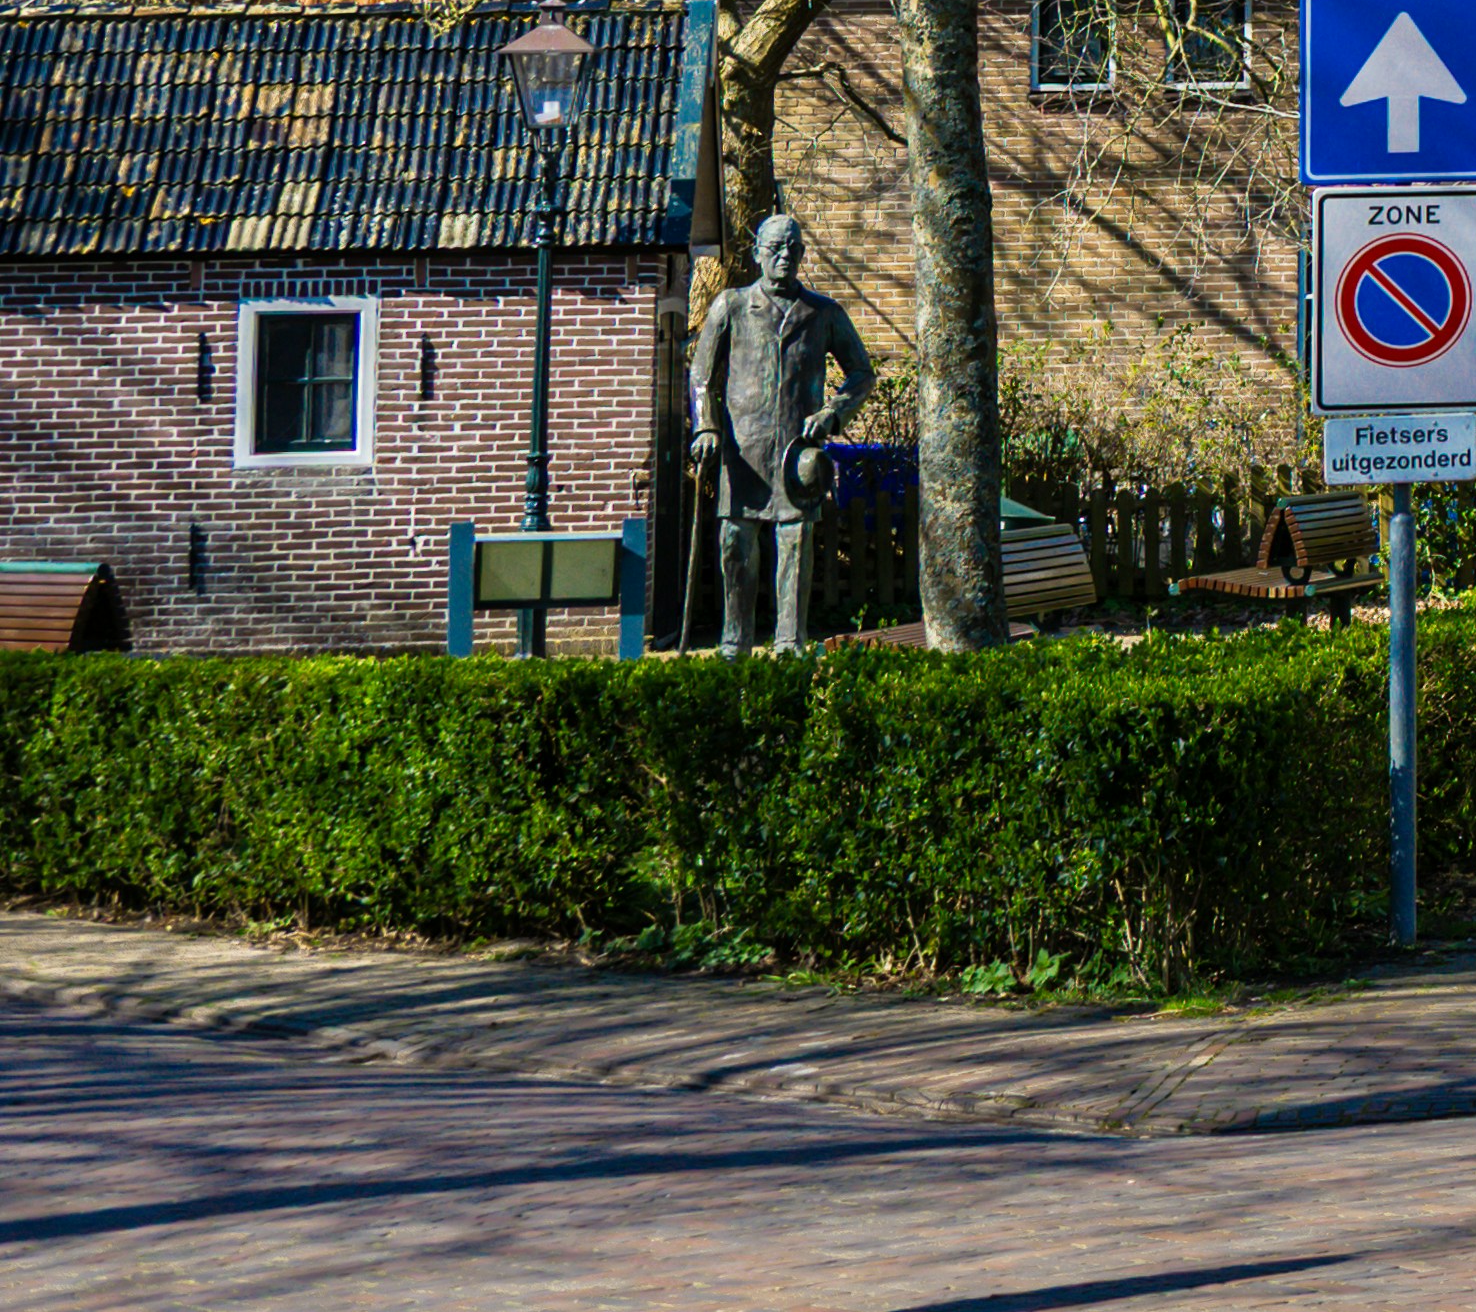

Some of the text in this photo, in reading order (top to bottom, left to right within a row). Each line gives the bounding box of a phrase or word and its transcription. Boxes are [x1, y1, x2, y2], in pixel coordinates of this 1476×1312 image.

[1368, 204, 1441, 225] ZONE
[1355, 426, 1448, 446] Fietsers
[1332, 447, 1471, 475] uitgezonderd
